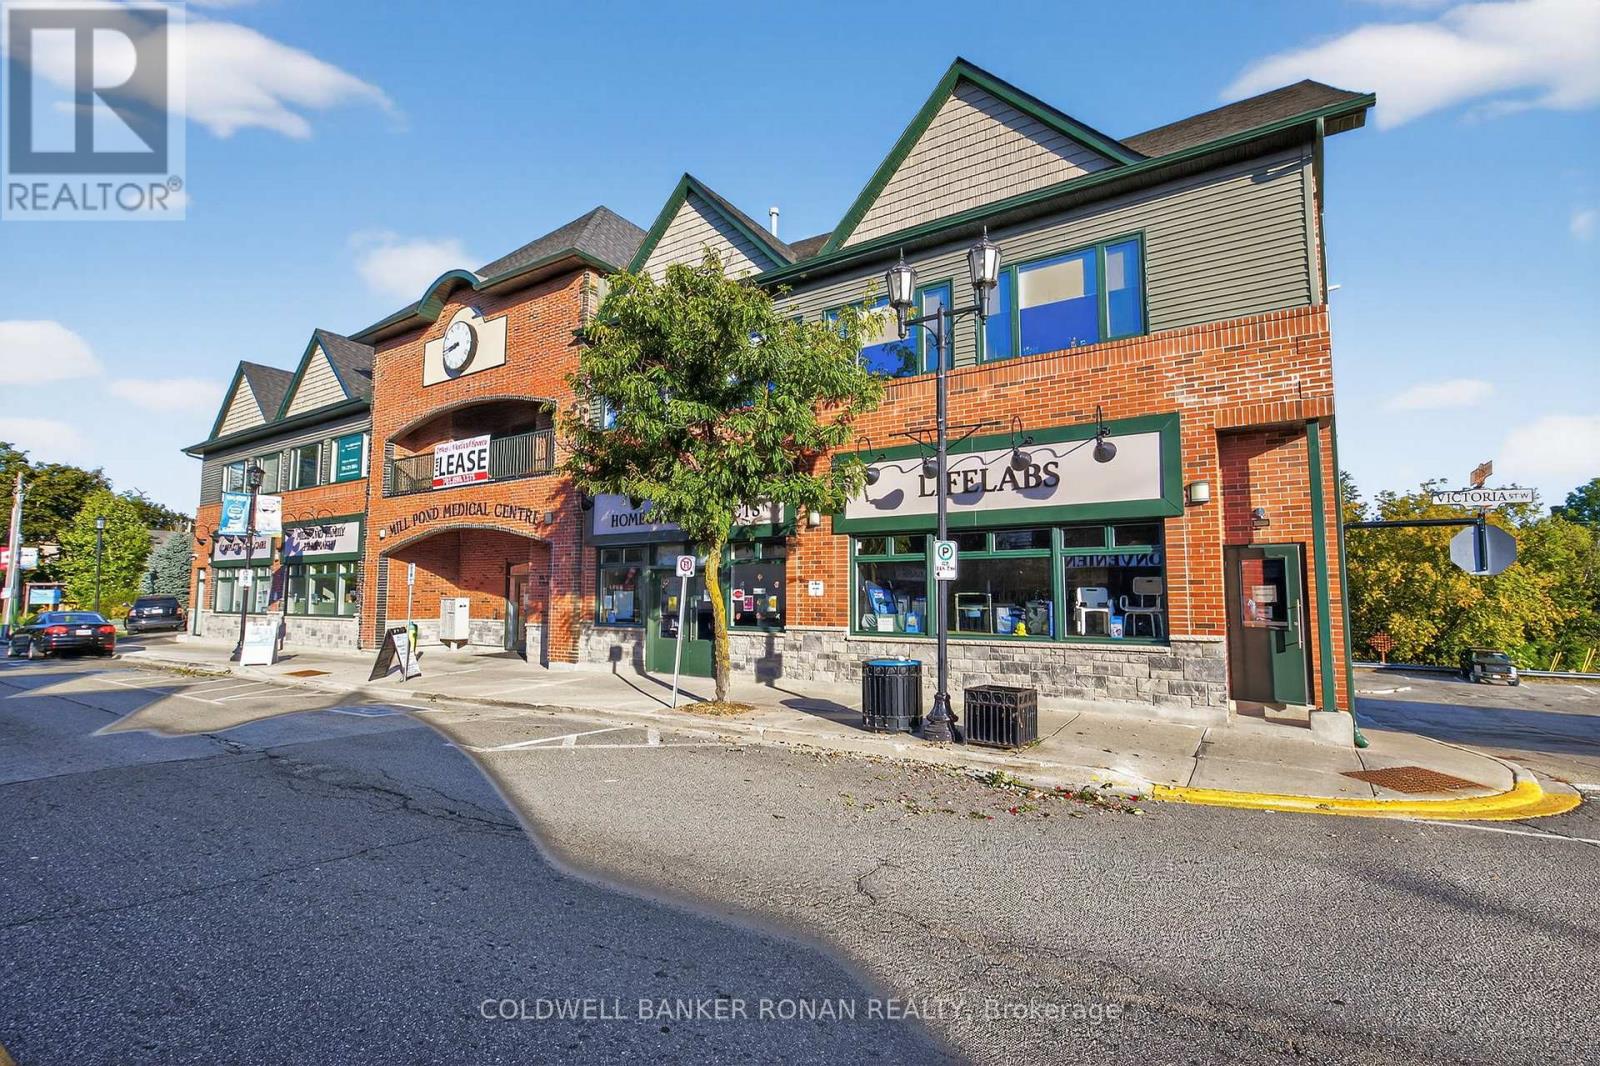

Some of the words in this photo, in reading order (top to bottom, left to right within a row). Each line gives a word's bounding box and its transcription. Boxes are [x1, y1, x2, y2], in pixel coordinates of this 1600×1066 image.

[439, 449, 487, 476] LEASE
[918, 461, 1060, 498] LFELABS
[1436, 491, 1507, 503] VICTORIA
[389, 517, 410, 536] MILL
[412, 507, 439, 527] POND
[443, 502, 490, 519] MEDICAL
[494, 503, 540, 526] CENTRE
